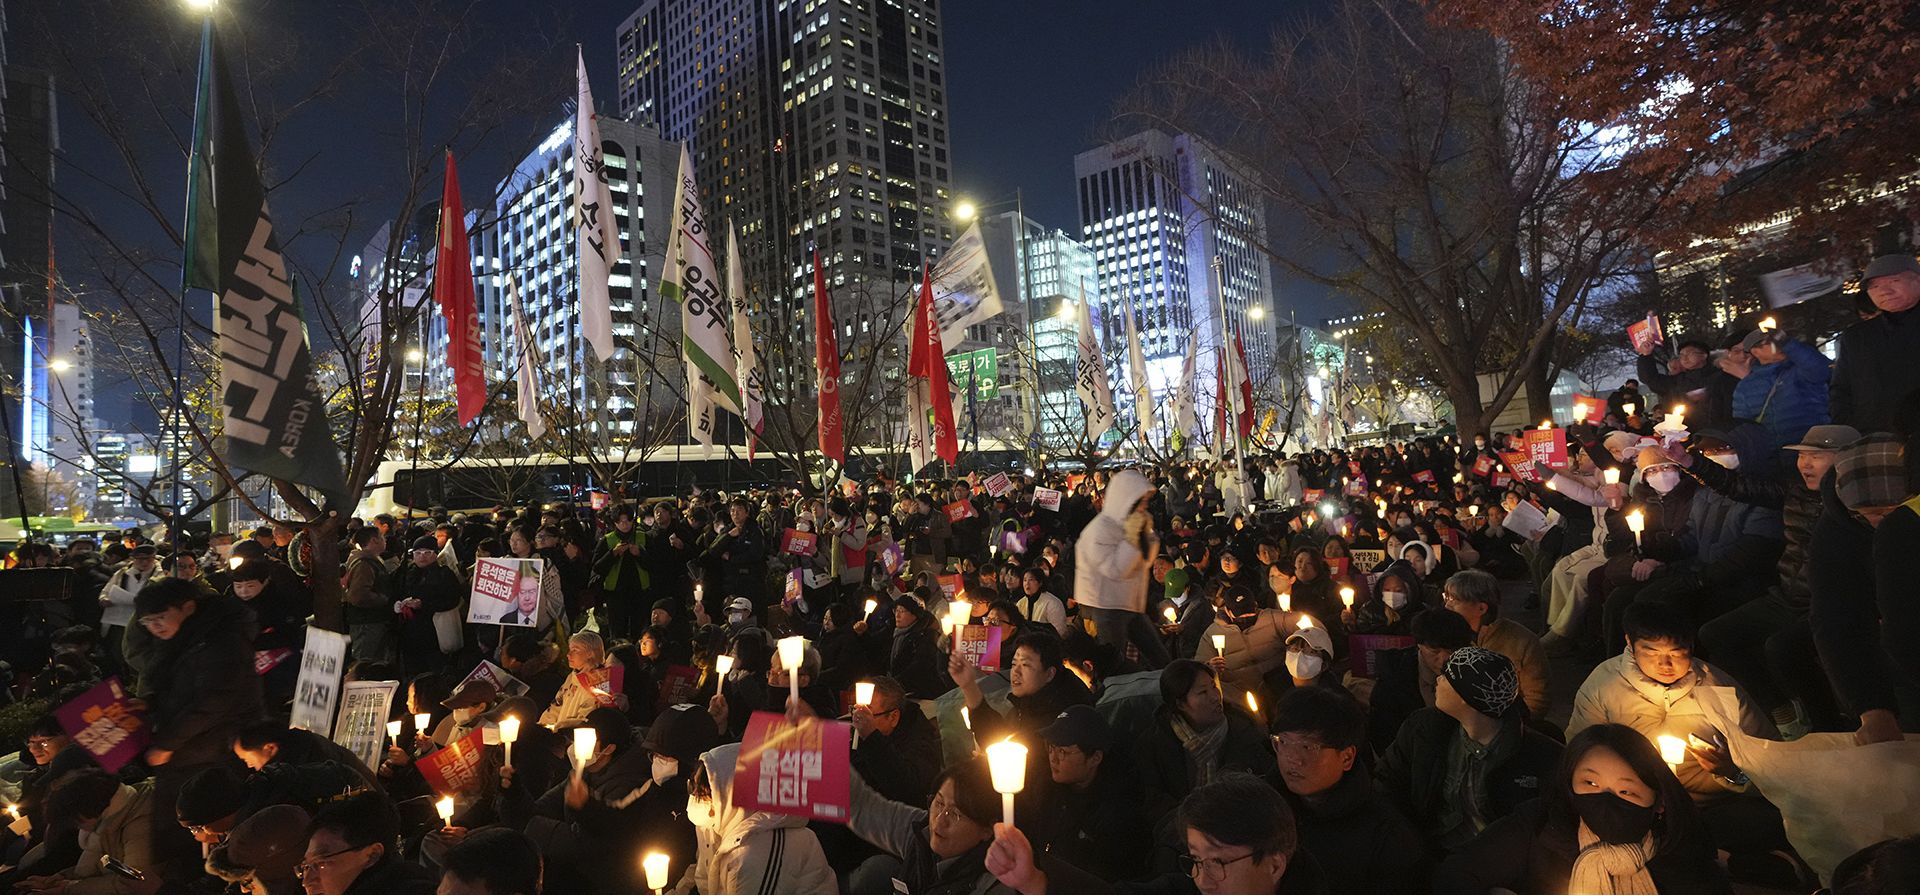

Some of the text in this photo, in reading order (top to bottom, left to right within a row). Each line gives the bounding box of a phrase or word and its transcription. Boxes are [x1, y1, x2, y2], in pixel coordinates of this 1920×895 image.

[1531, 441, 1554, 455] 윤석열
[480, 563, 517, 585] 윤석열은
[476, 577, 513, 600] 퇴진하라
[960, 641, 988, 654] 윤석열
[760, 748, 823, 781] 윤석열
[757, 775, 808, 807] 퇴진!
